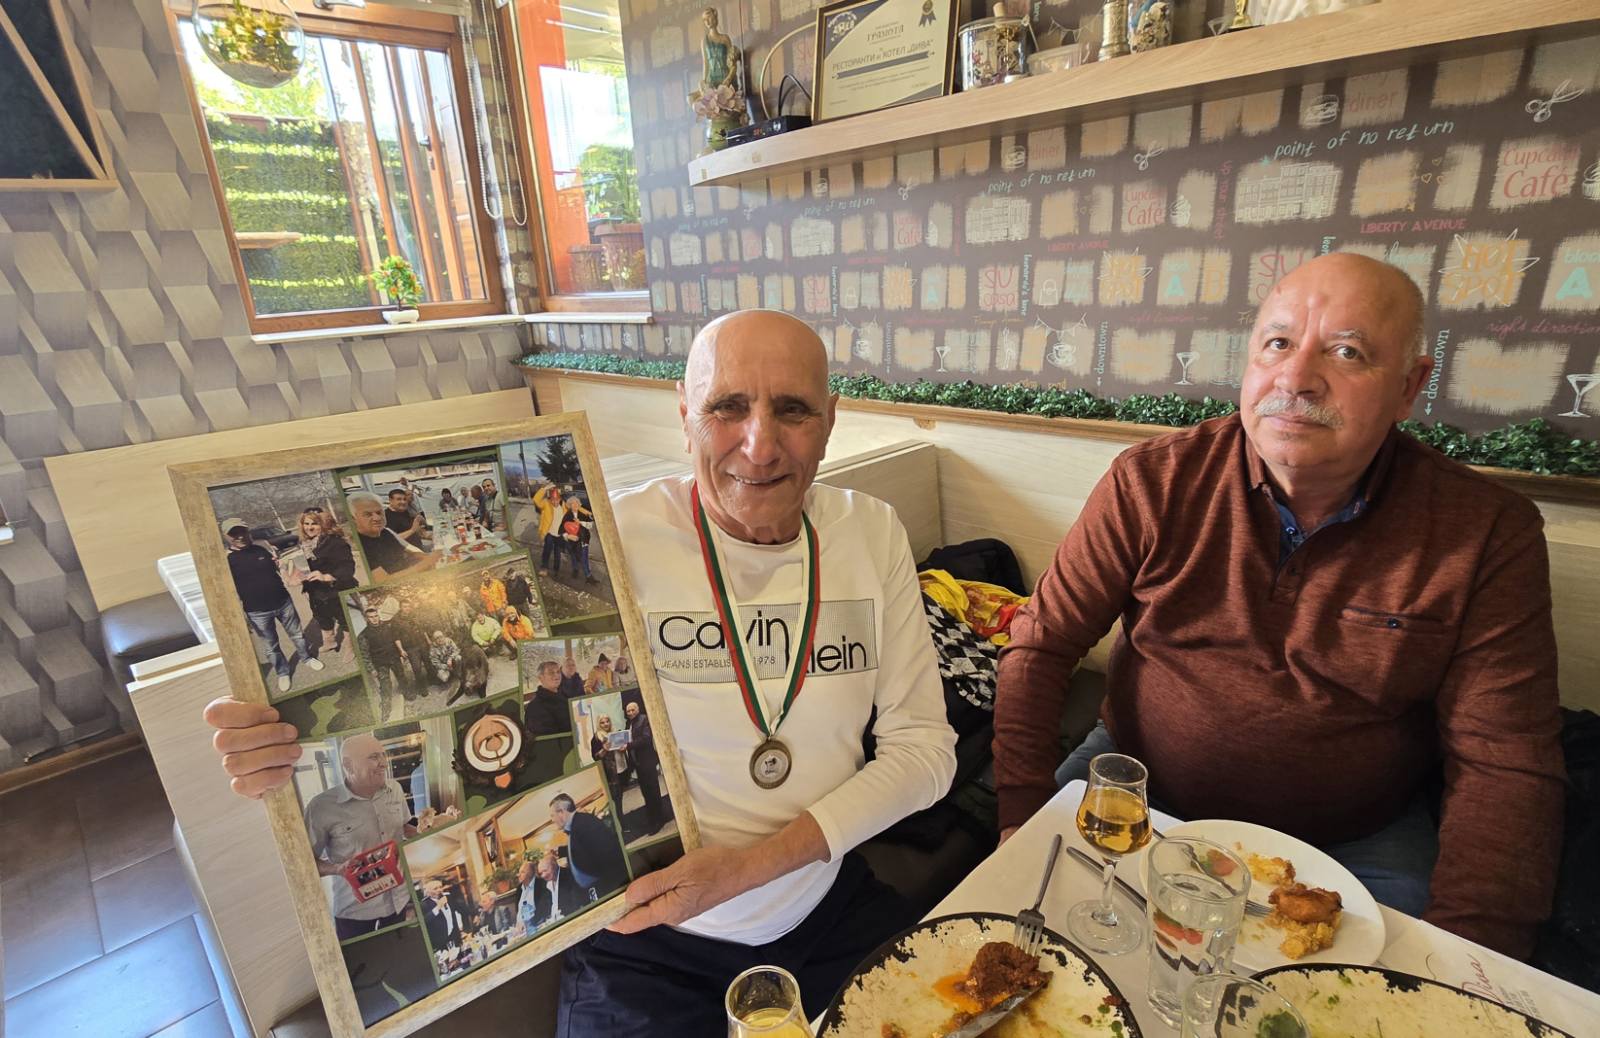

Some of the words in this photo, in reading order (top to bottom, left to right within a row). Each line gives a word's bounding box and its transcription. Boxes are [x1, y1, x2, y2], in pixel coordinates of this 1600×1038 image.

[1274, 141, 1316, 160] point
[1327, 130, 1351, 150] of
[1358, 130, 1379, 145] no
[1503, 165, 1569, 198] Café
[1360, 221, 1408, 234] LIBERTY
[1412, 218, 1467, 232] AVENUE
[659, 610, 790, 651] Cavin
[661, 659, 691, 669] JEANS
[694, 658, 731, 669] ESTABLIS
[785, 635, 867, 673] lein
